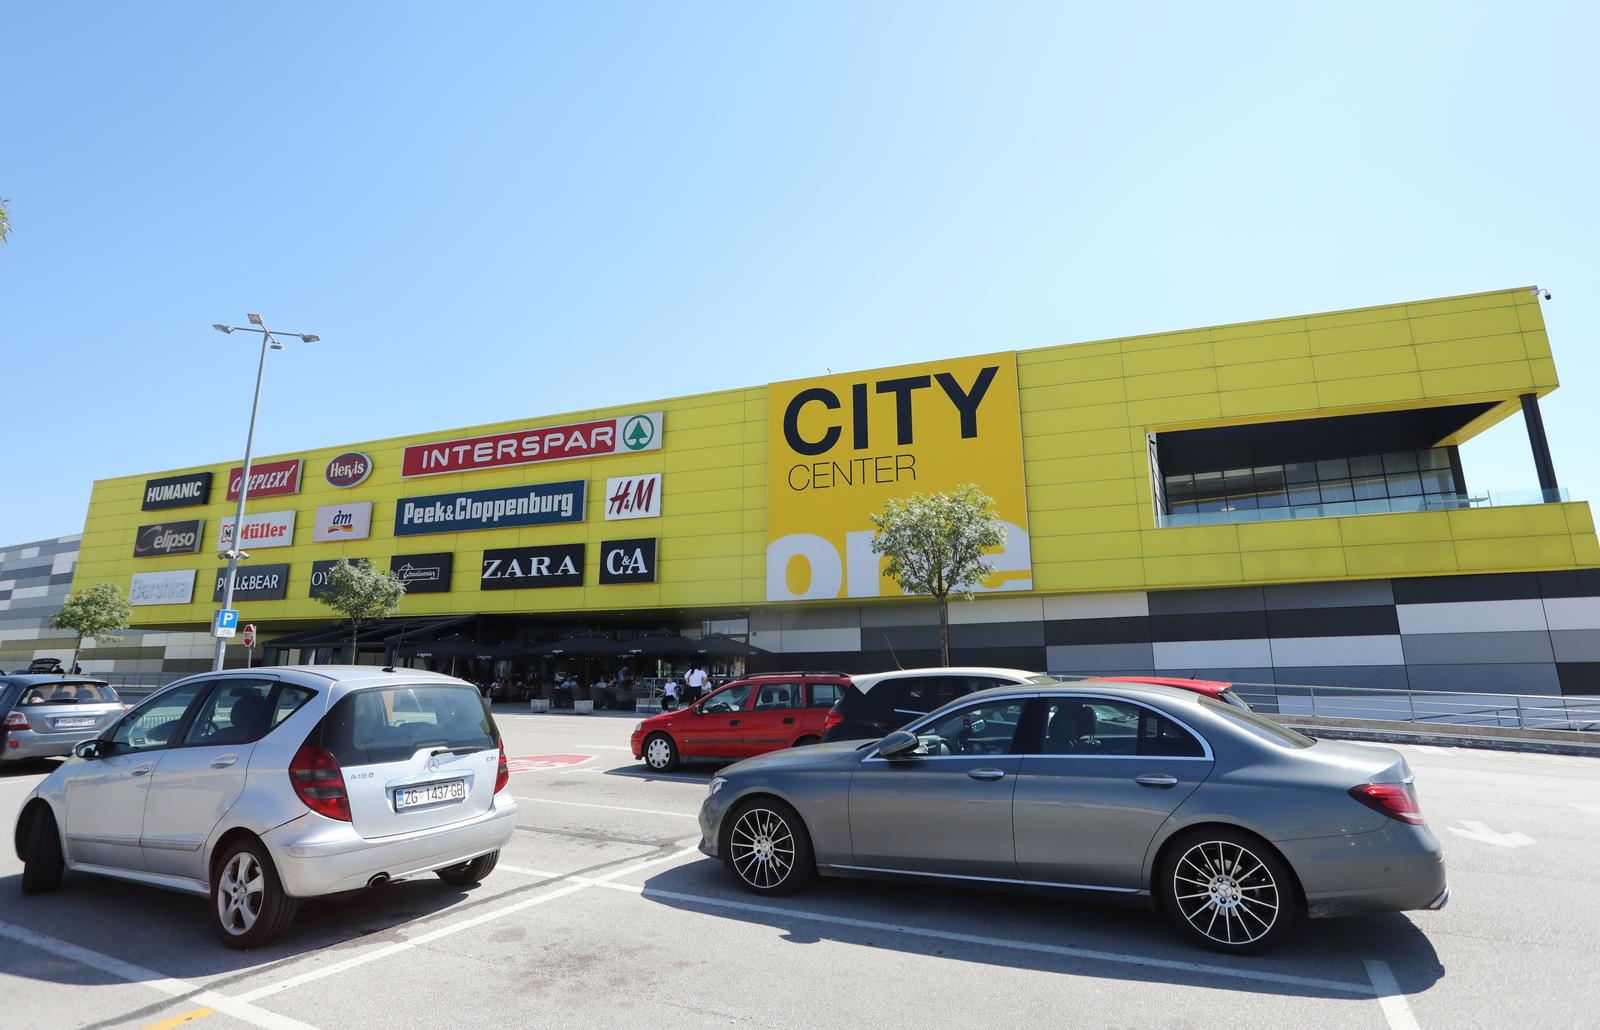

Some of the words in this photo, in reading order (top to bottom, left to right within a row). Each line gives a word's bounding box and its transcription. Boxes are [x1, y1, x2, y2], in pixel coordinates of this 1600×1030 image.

[783, 366, 1000, 456] CITY
[421, 426, 613, 469] INTERSPAR
[330, 460, 364, 479] Hervis
[788, 454, 916, 491] CENTER
[146, 481, 203, 503] HUMANIC
[608, 478, 656, 515] H&M
[332, 510, 352, 525] dm
[403, 492, 573, 523] Peek&Cloppenburg
[153, 529, 195, 553] elipso
[240, 523, 287, 540] Müller
[482, 554, 580, 579] ZARA
[606, 547, 648, 576] C&A
[216, 574, 279, 592] PL&BEAR
[223, 612, 234, 626] P
[404, 790, 418, 805] ZG
